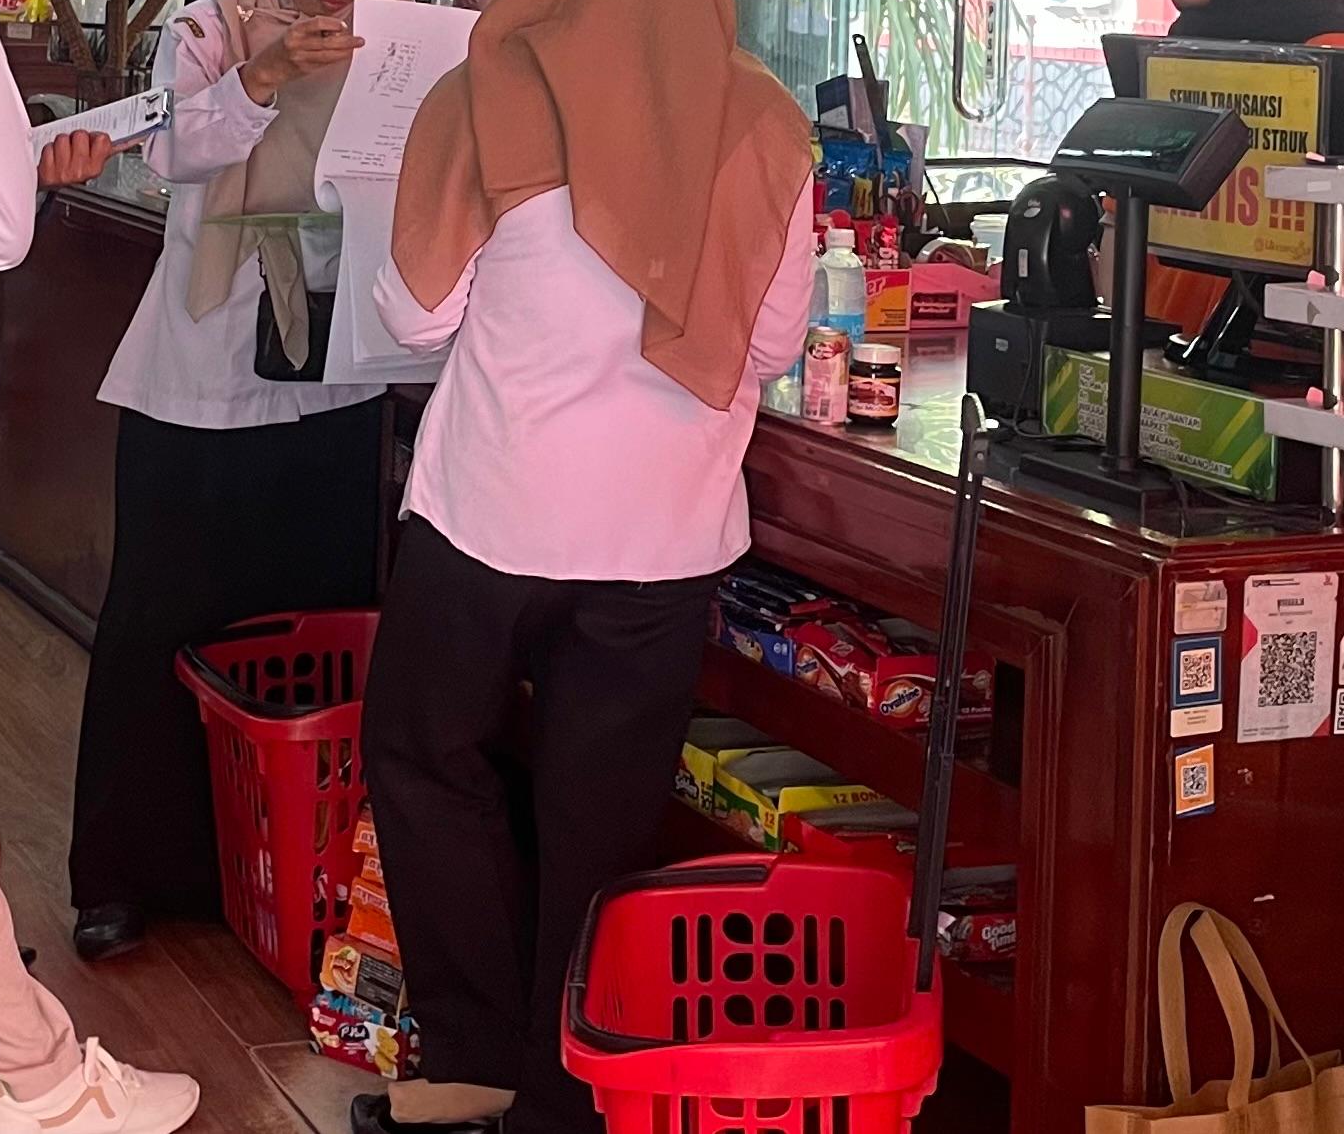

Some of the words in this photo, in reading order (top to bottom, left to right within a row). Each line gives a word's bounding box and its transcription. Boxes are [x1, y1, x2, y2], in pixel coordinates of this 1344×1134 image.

[1211, 91, 1283, 118] TRANSAKSI
[1263, 129, 1309, 153] STRUK
[880, 687, 921, 715] Ovaltine
[982, 919, 1016, 940] Good
